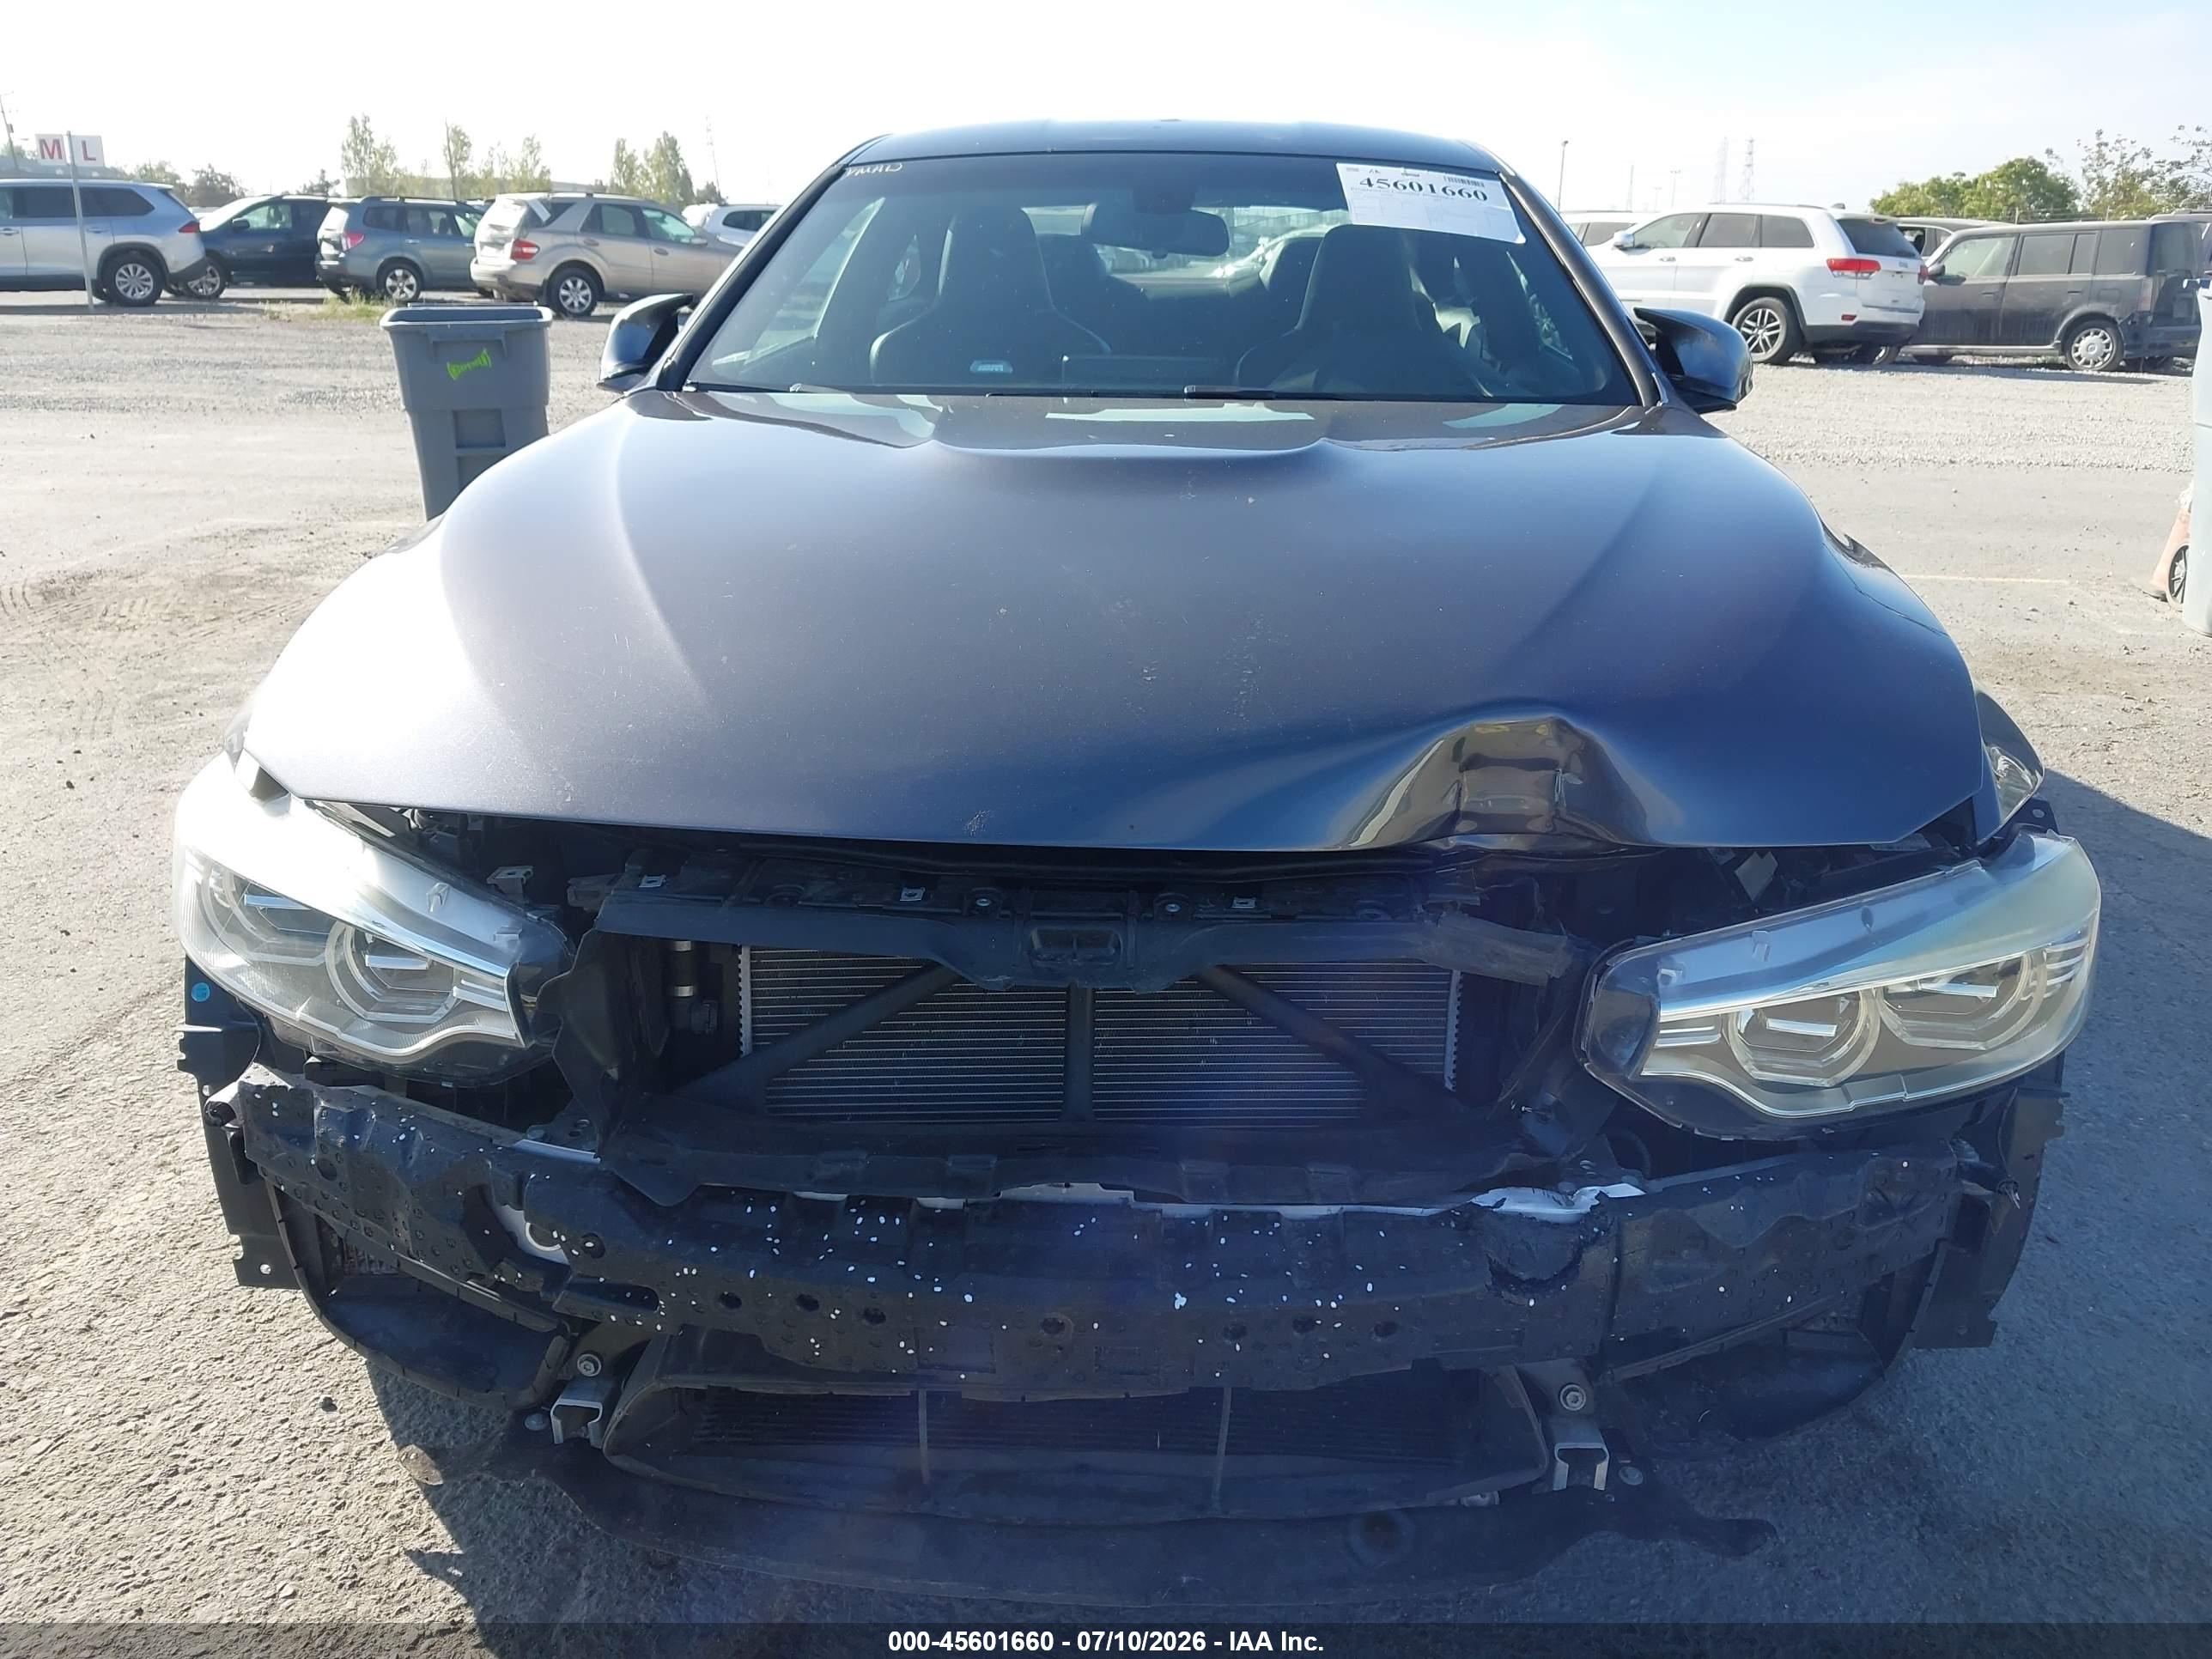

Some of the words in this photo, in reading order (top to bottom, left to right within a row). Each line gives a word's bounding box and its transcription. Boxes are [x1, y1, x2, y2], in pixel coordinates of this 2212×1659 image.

[39, 138, 63, 160] M
[82, 140, 96, 161] L
[1359, 176, 1488, 202] 45601660
